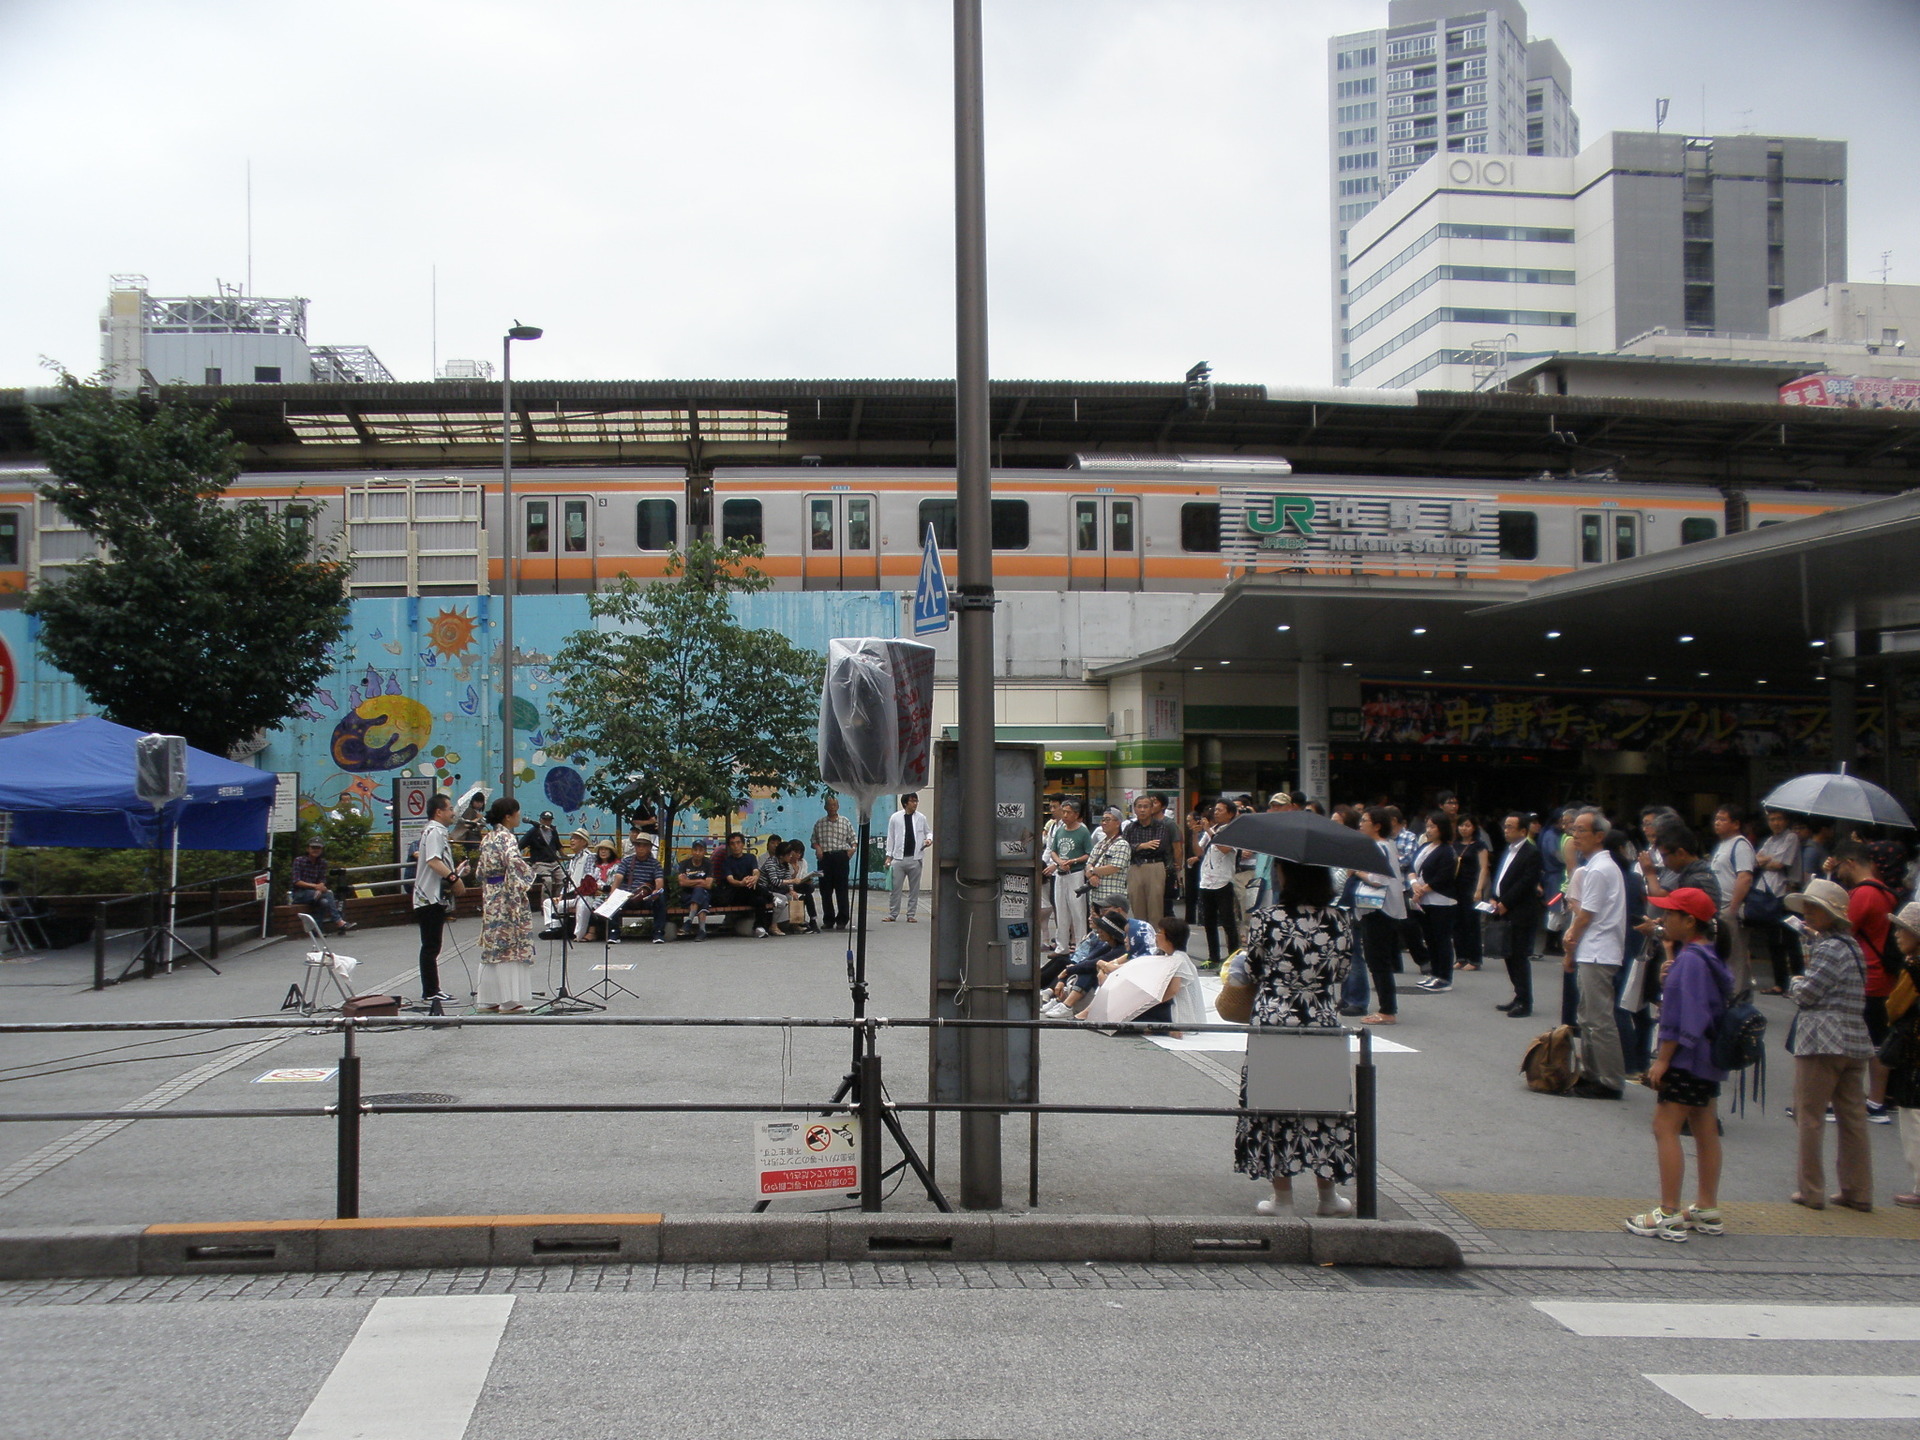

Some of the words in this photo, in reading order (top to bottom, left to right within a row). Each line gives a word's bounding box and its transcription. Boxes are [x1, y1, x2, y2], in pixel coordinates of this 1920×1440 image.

[1247, 496, 1317, 535] JR
[1329, 498, 1481, 532] 中野駅
[1258, 536, 1308, 549] JR東日本
[1329, 535, 1403, 551] Nakano
[1411, 537, 1482, 555] Station
